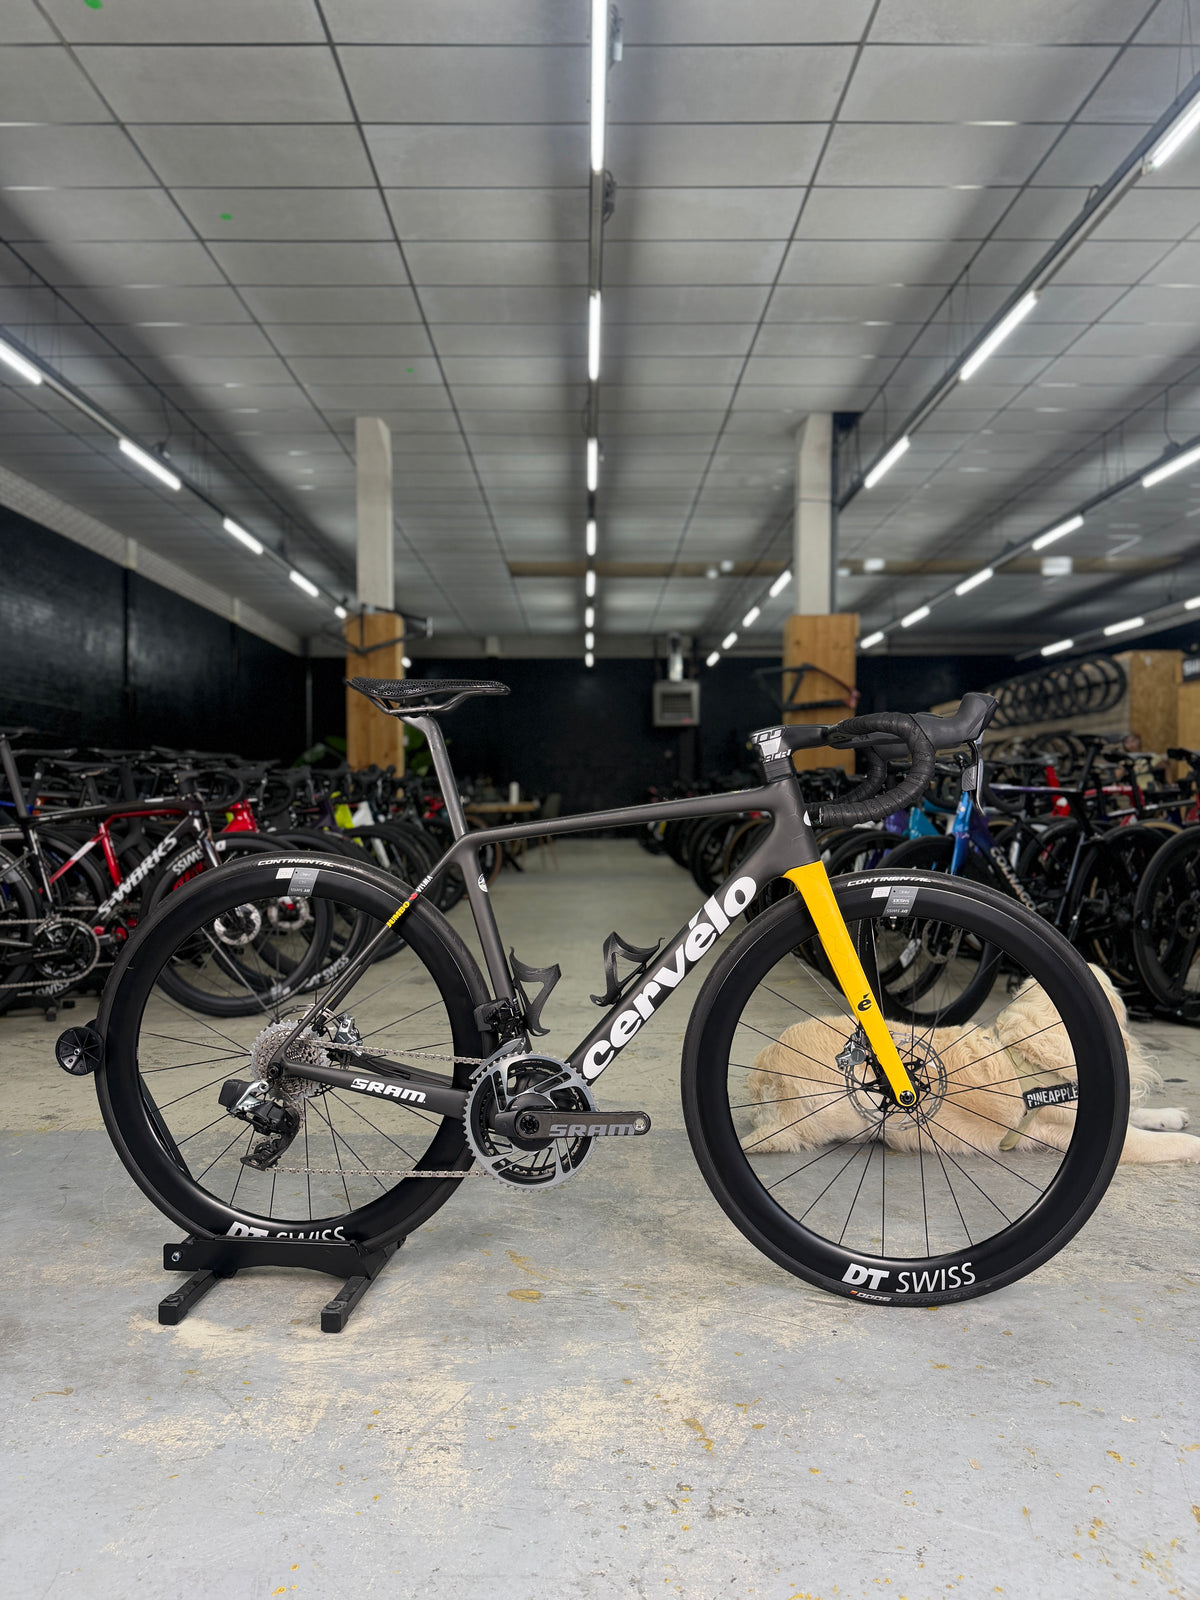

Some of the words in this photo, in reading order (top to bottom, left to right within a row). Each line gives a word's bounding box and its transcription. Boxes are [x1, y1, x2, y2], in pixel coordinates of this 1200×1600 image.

[98, 835, 177, 920] S-WORKS
[847, 876, 932, 887] CONTINENTAL
[386, 901, 410, 928] JUMBO
[415, 875, 433, 892] VISMA
[582, 876, 757, 1080] cervélo
[350, 1078, 427, 1104] SRAM
[1026, 1086, 1079, 1108] PINEAPPLE
[549, 1124, 635, 1136] SRAM
[841, 1262, 890, 1290] DT
[895, 1262, 976, 1293] SWISS
